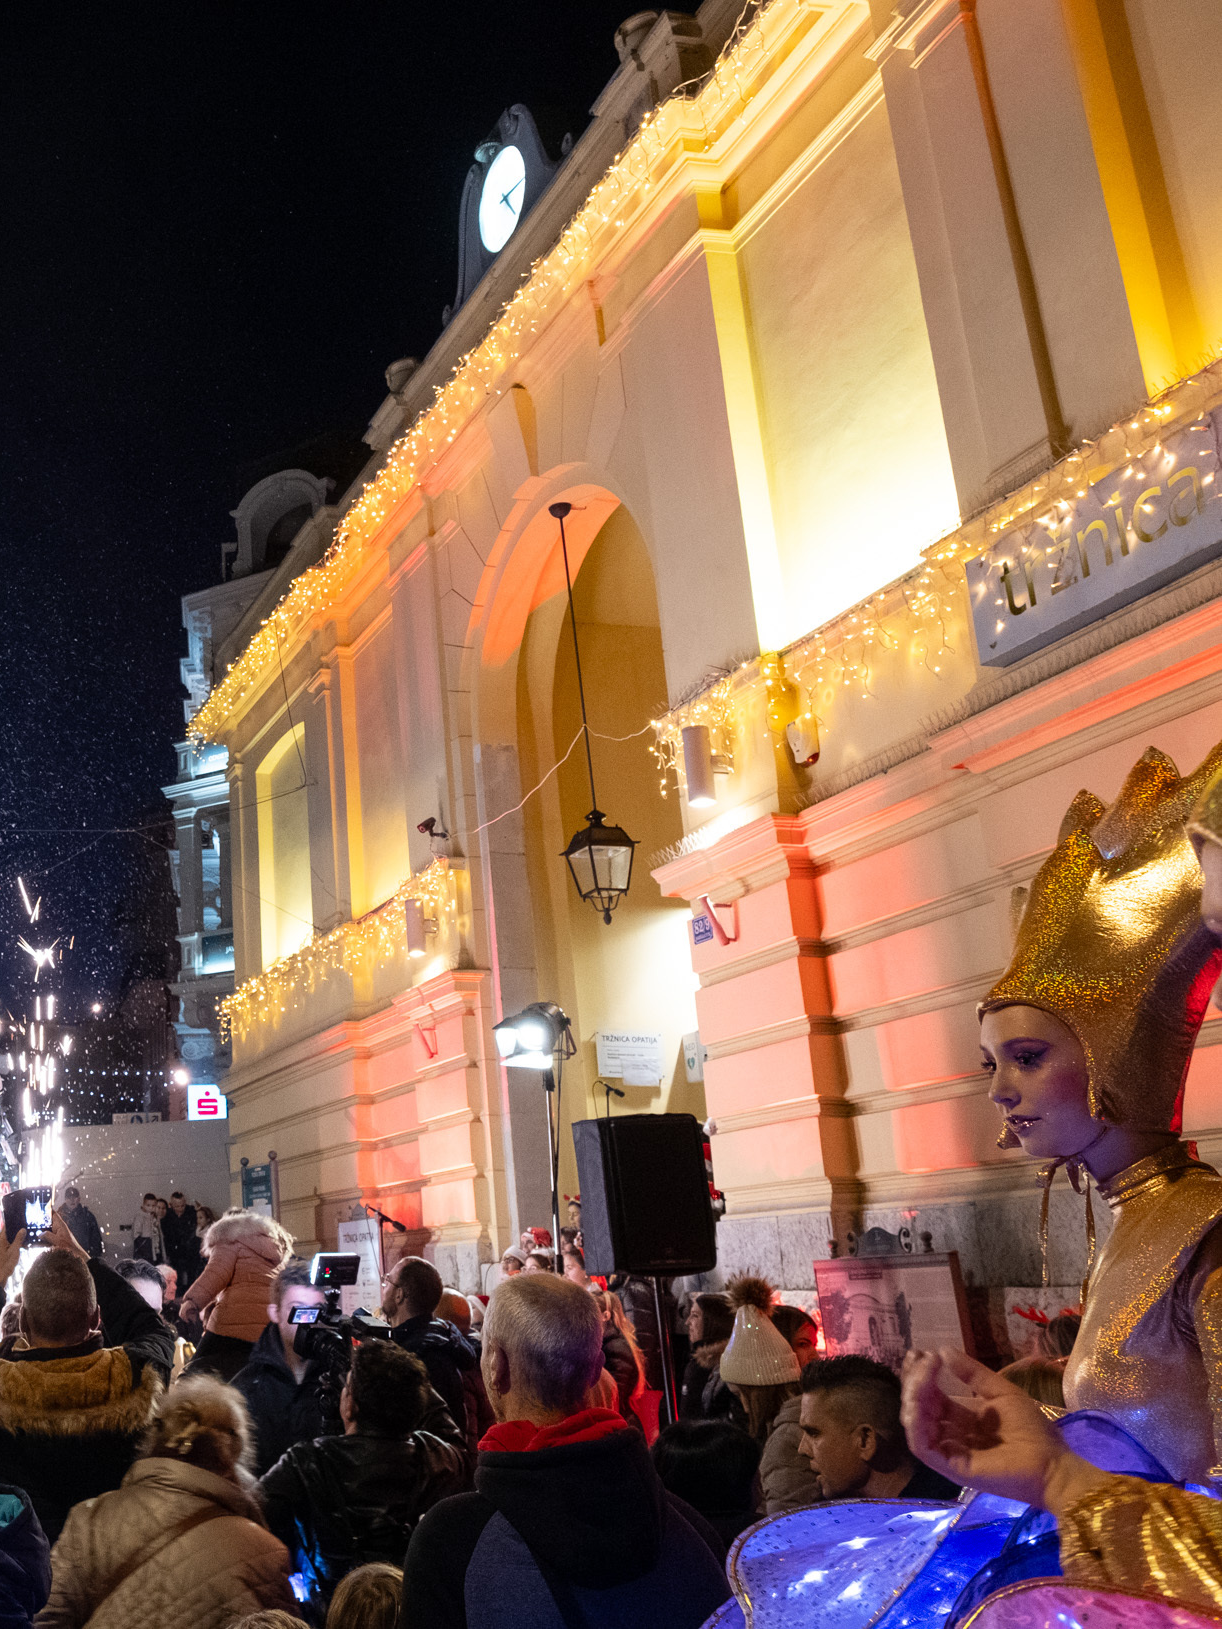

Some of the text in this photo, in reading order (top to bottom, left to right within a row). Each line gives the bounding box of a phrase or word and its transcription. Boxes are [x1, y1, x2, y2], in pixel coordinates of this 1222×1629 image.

[1000, 466, 1205, 616] tržnica
[601, 1034, 658, 1045] TRŽNICA OPATIJA
